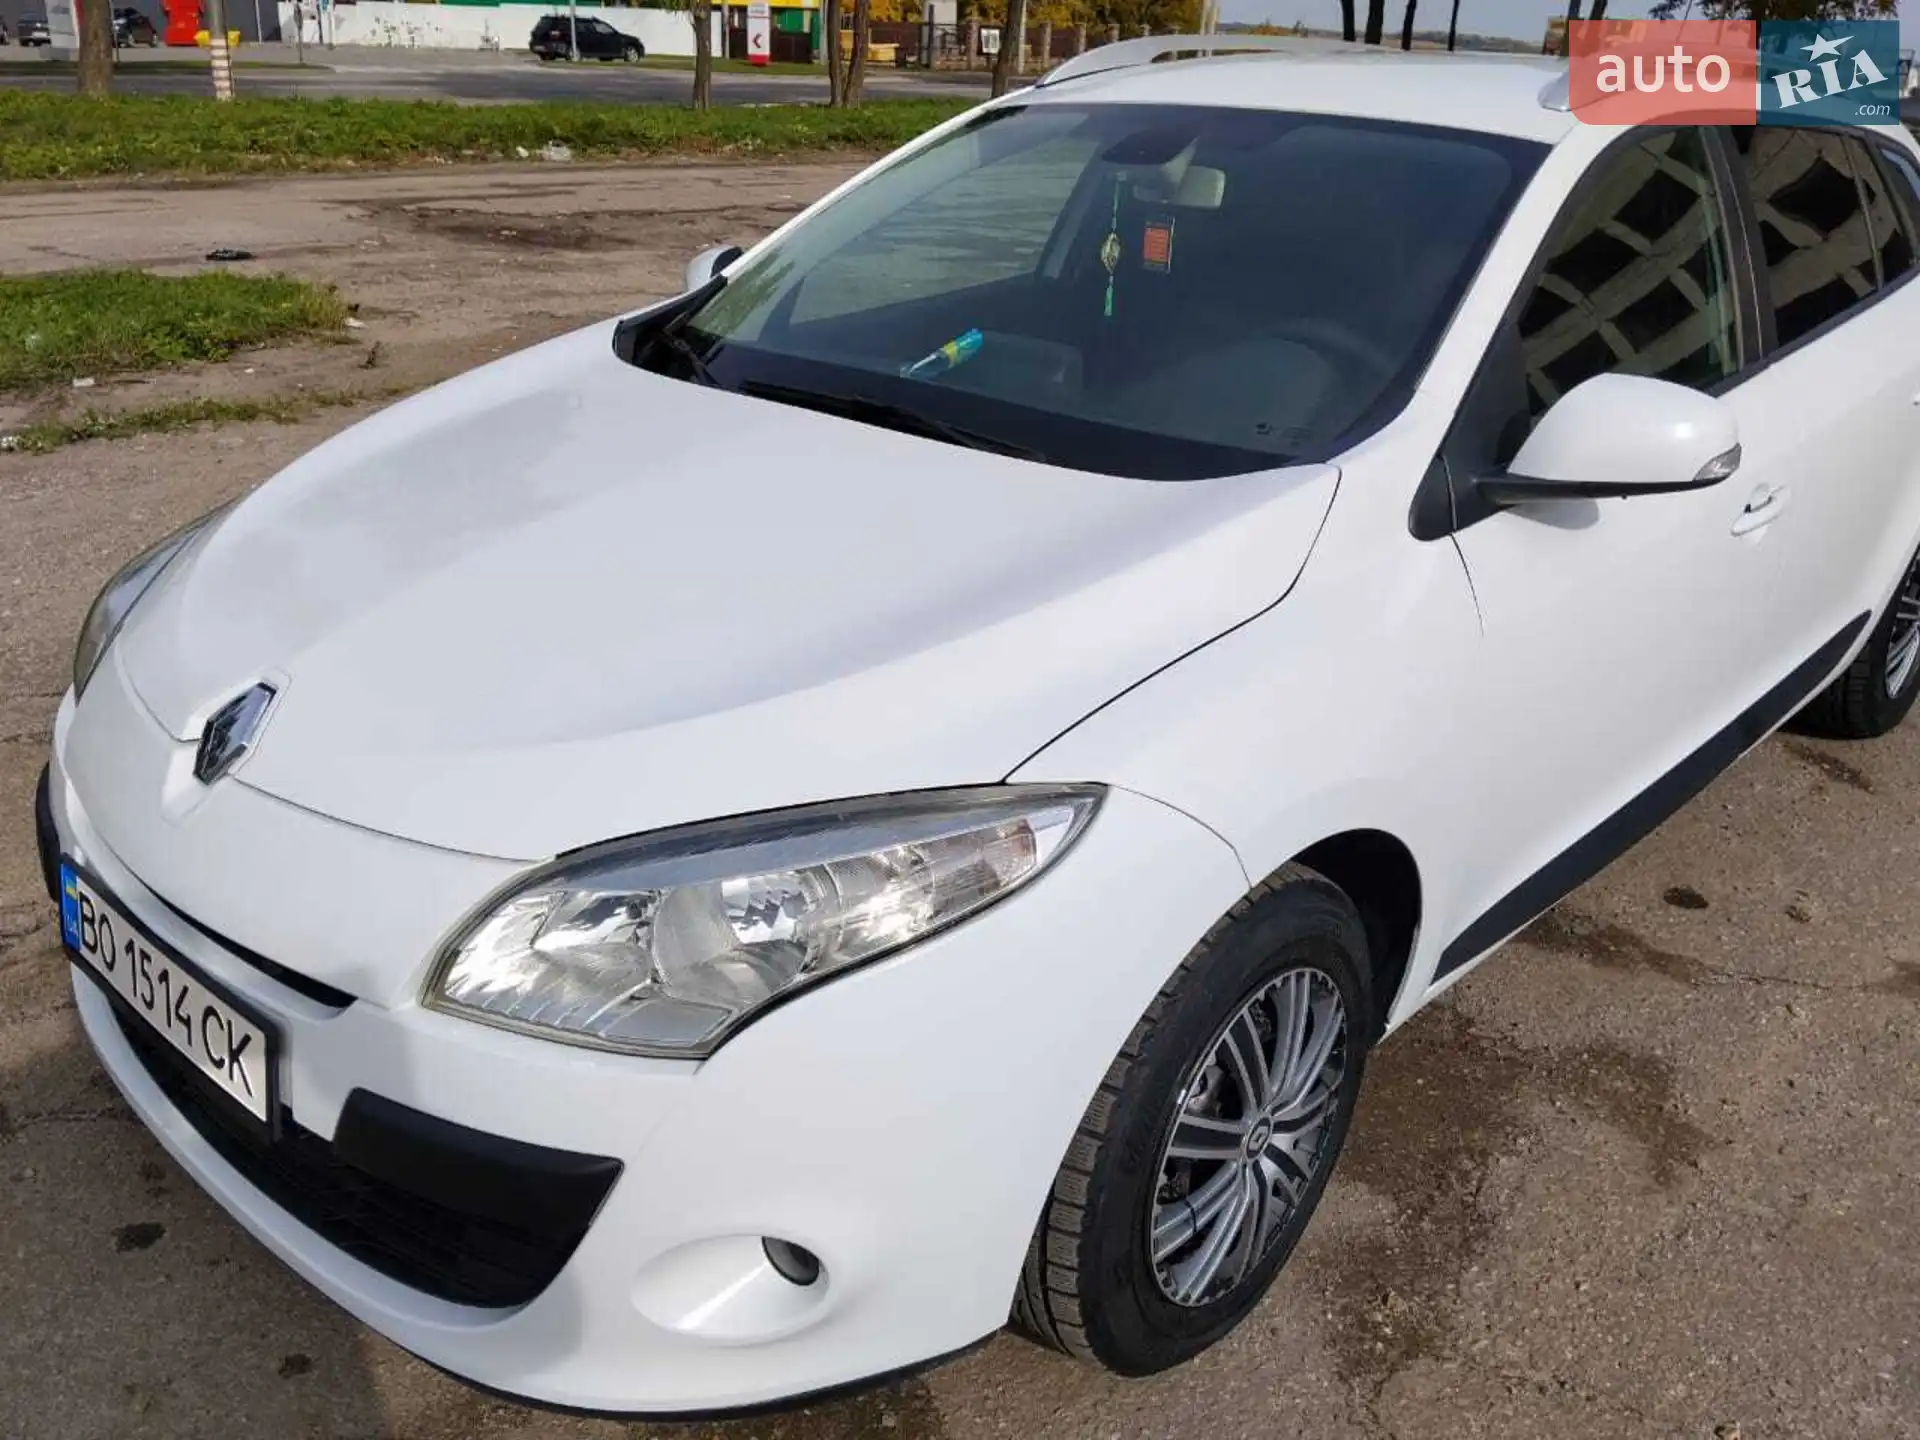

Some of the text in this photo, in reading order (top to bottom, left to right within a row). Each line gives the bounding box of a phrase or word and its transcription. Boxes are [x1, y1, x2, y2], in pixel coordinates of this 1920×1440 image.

[79, 893, 252, 1097] BO 1514 CK
